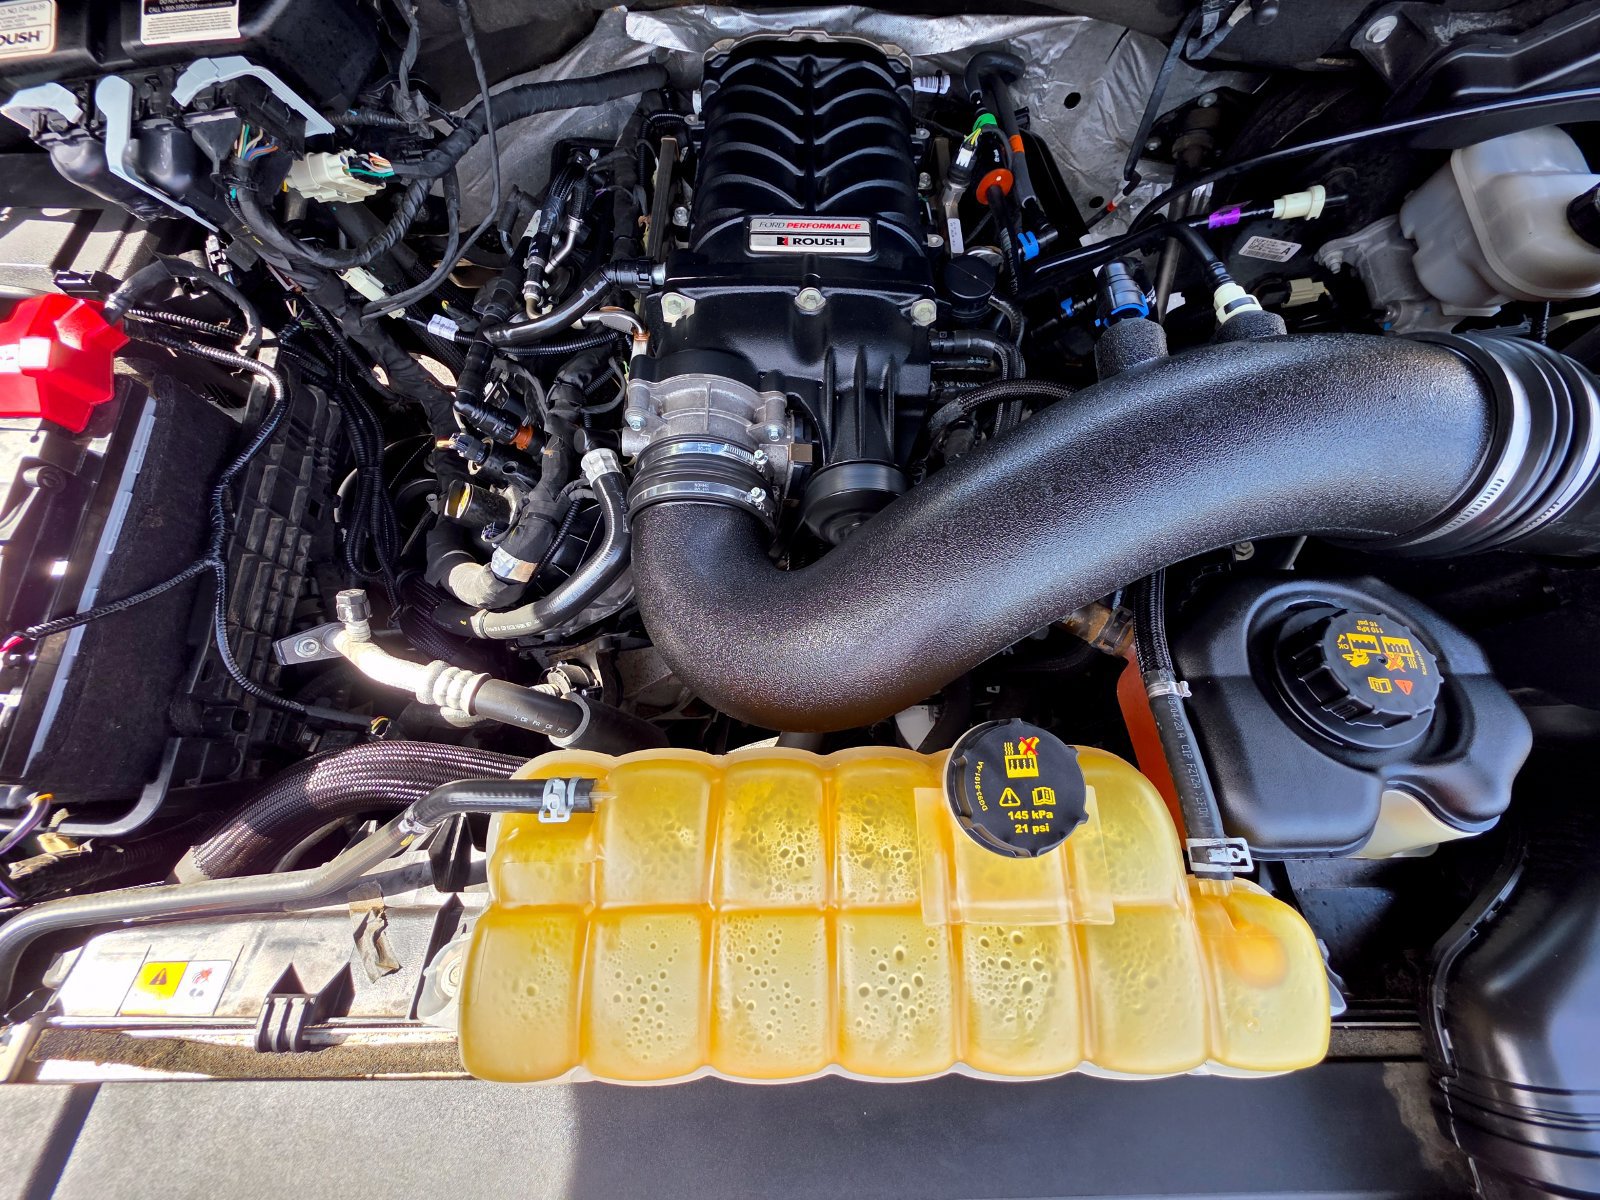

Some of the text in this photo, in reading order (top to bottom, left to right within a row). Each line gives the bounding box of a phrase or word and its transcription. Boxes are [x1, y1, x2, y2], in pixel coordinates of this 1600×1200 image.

[759, 221, 785, 229] FORD
[793, 238, 845, 246] ROUSH
[1168, 695, 1184, 731] 08/04/20
[1008, 810, 1053, 820] 145 kPa
[1015, 823, 1049, 834] 21 psi
